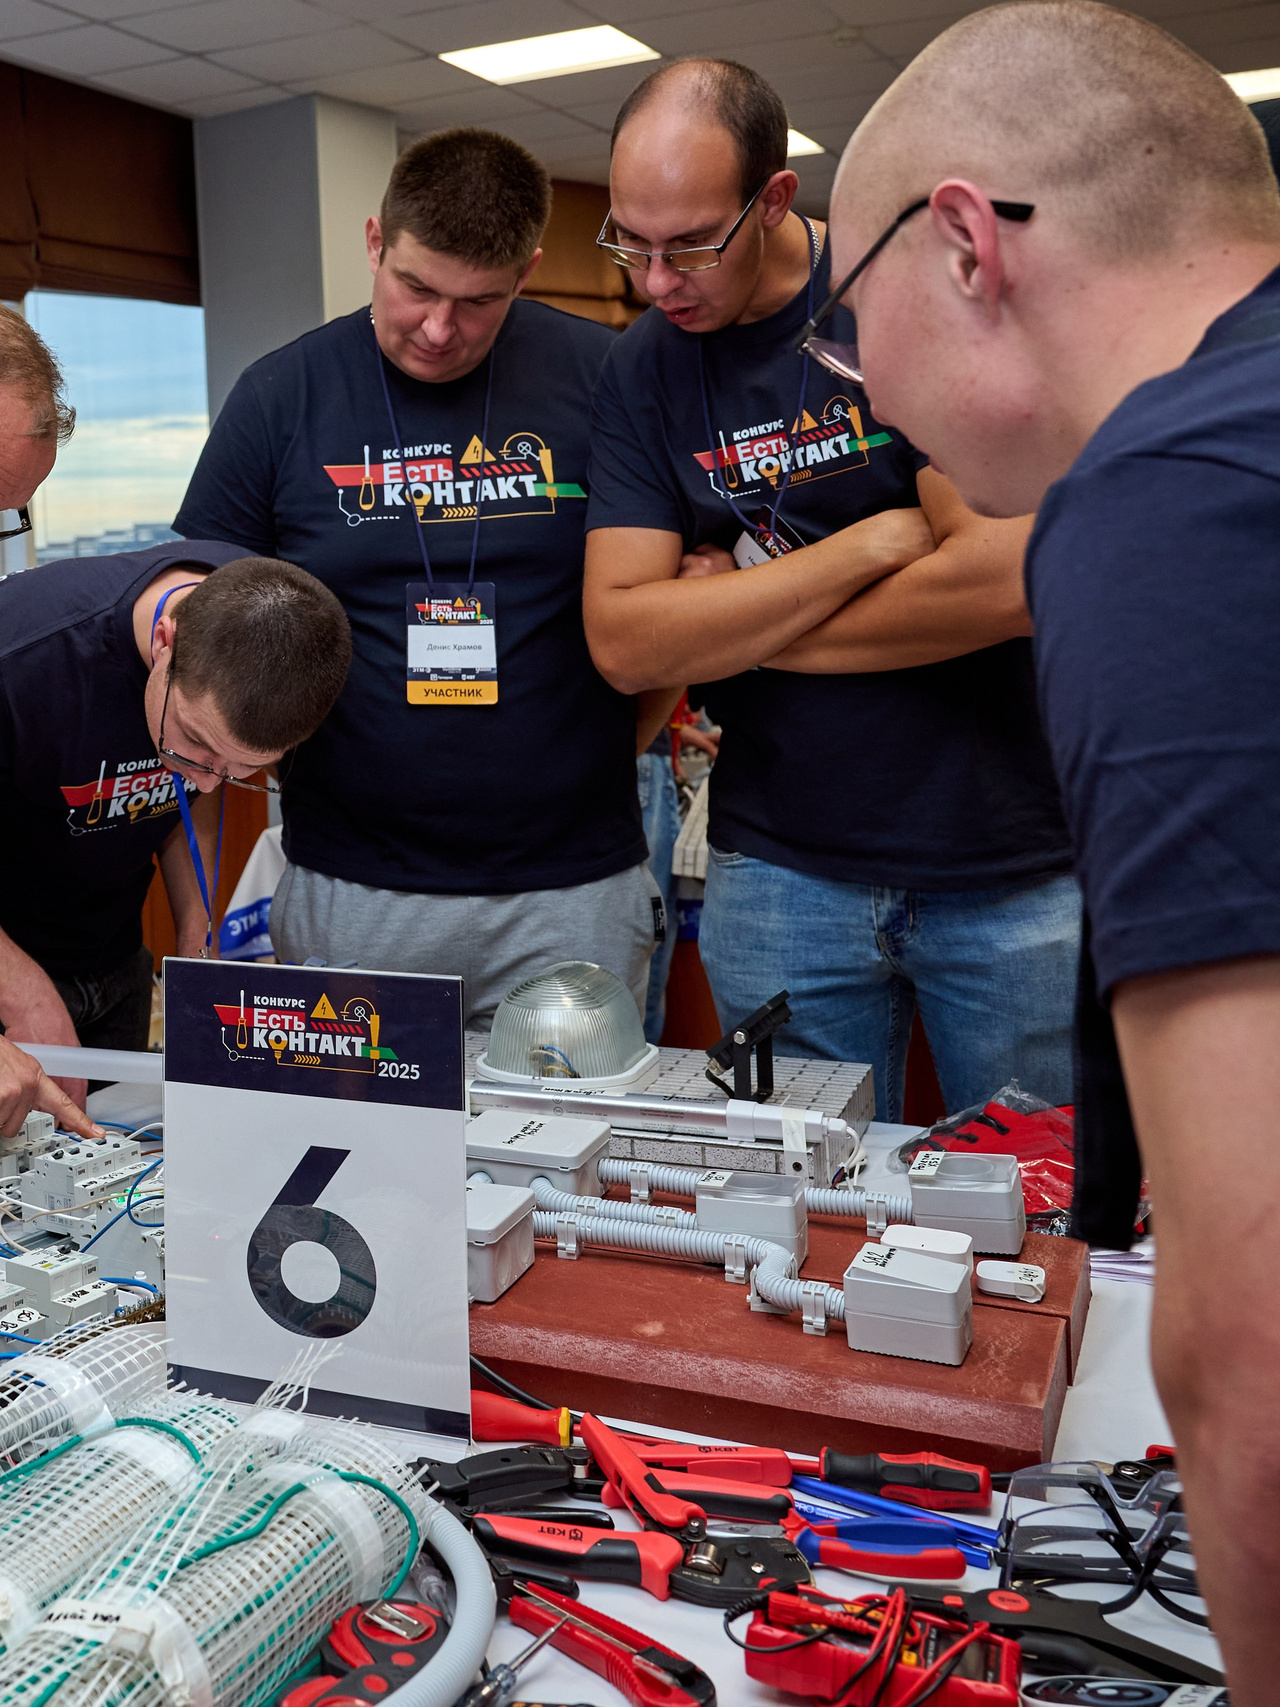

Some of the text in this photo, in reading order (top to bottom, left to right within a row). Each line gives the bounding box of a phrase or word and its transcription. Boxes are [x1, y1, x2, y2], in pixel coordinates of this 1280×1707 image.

[733, 419, 784, 441] КОНКУРС
[739, 433, 850, 484] КОНТАКТ
[383, 475, 538, 506] КОНТАКТ
[430, 611, 476, 620] КОНТАКТ
[424, 688, 482, 697] УЧАСТНИК
[253, 995, 306, 1009] КОНКУРС
[253, 1028, 366, 1057] КОНТАКТ
[378, 1061, 421, 1080] 2025
[247, 1145, 377, 1339] 6
